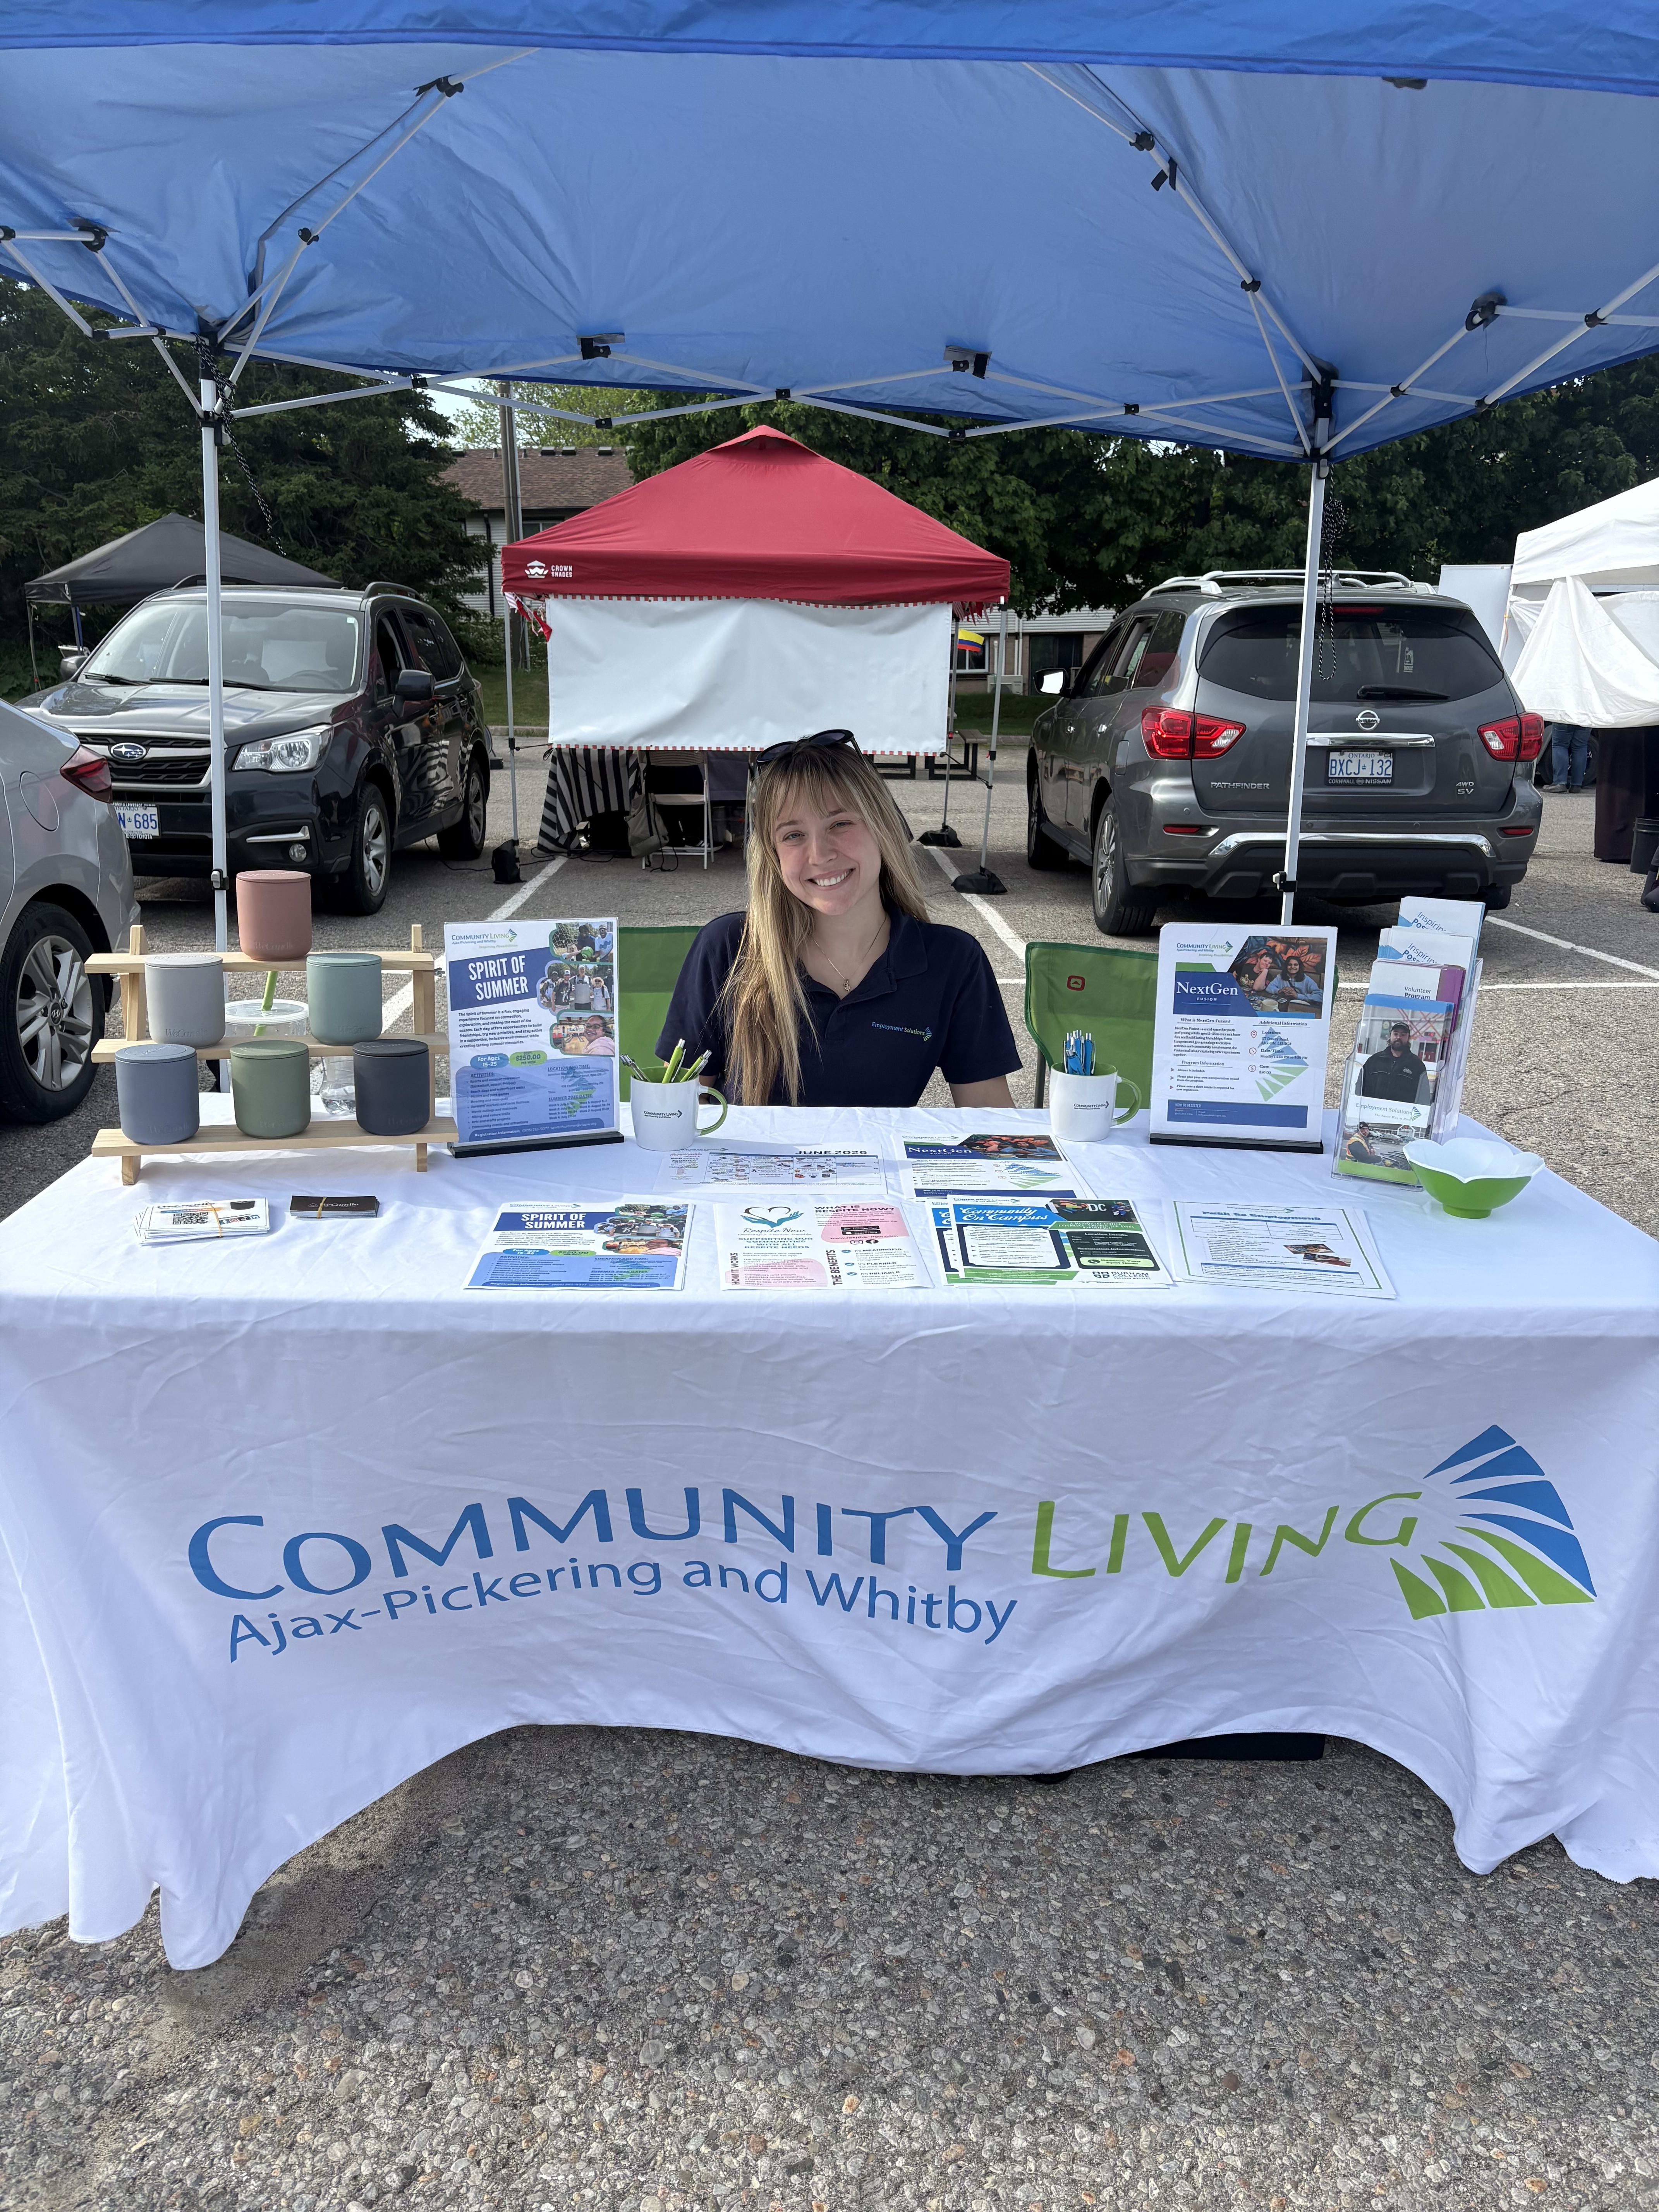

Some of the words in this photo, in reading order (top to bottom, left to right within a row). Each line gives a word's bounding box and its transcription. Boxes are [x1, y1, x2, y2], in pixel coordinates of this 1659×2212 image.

[1330, 759, 1360, 776] BXCJ
[1370, 759, 1391, 776] 132
[134, 813, 157, 829] 685
[1417, 912, 1447, 932] Inspirin
[1408, 943, 1438, 964] Inspirin
[468, 958, 507, 981] SPIRIT
[511, 955, 525, 974] OF
[476, 976, 529, 1000] SUMMER
[1176, 982, 1238, 995] NextGen
[1405, 993, 1431, 1001] Program
[872, 1021, 903, 1032] Employment
[904, 1027, 925, 1036] Solutions
[1355, 1103, 1387, 1112] Employment
[1389, 1107, 1412, 1116] Solutions
[959, 1207, 1037, 1216] Community
[1086, 1203, 1107, 1212] DC
[986, 1214, 1048, 1223] Campus
[730, 1253, 738, 1268] WORKS
[826, 1250, 840, 1274] BENEFITS
[732, 1274, 740, 1285] HOW
[831, 1275, 843, 1285] THE
[188, 1487, 998, 1600] COMMUNITY
[1031, 1491, 1422, 1583] LIVING
[231, 1558, 661, 1663] Ajax-Pickering
[682, 1561, 787, 1603] and
[805, 1568, 1018, 1645] Whitby
